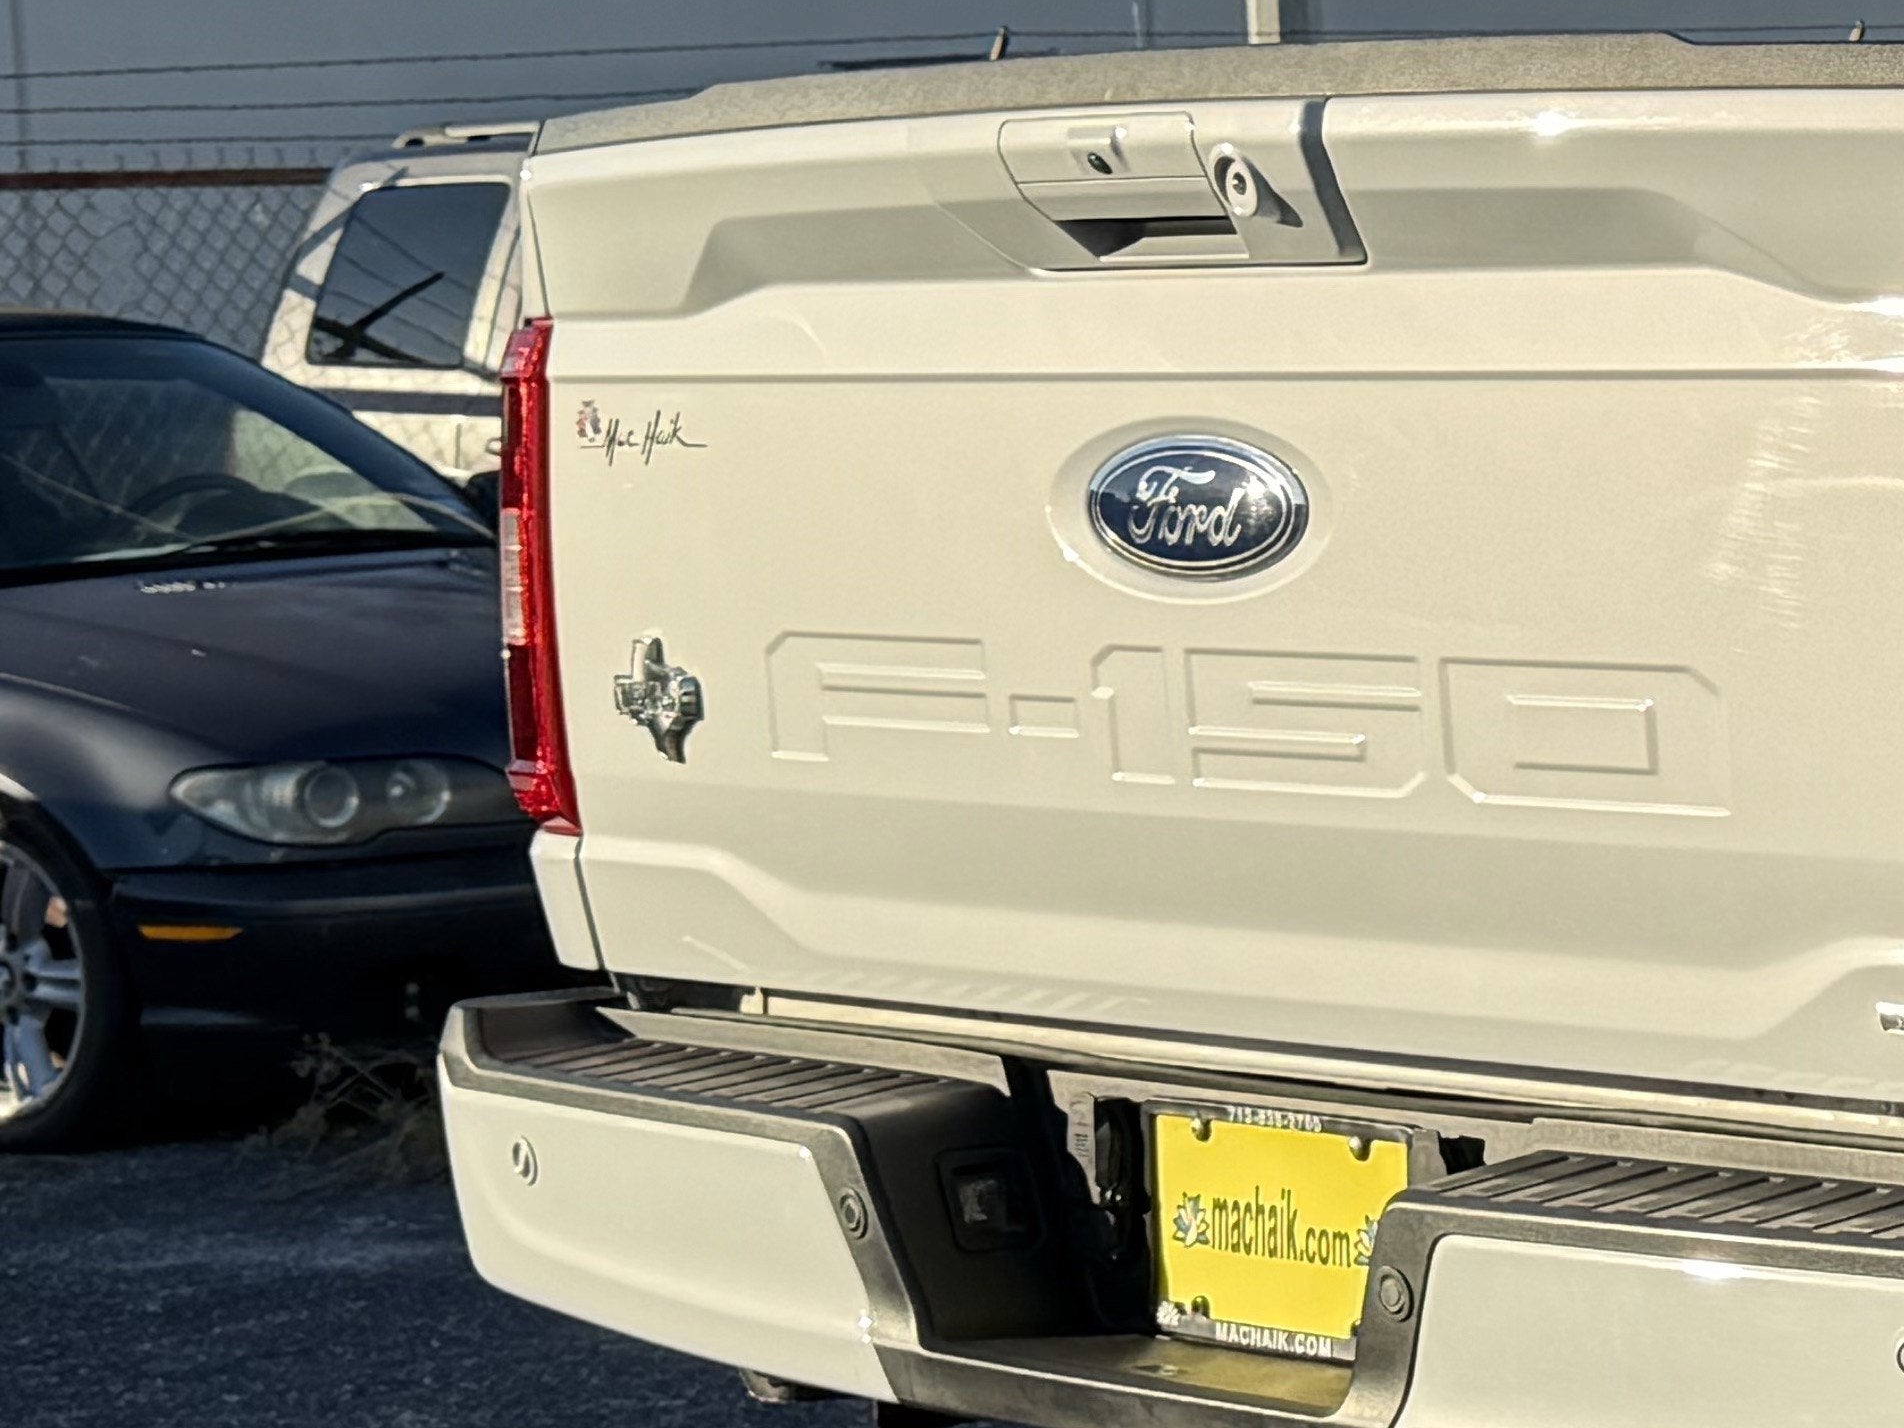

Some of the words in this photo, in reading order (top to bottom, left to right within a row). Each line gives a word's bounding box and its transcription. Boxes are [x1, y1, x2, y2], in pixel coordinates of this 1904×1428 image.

[641, 409, 708, 467] Haik
[1127, 463, 1243, 547] Ford
[765, 630, 1730, 818] F-150
[1211, 1185, 1352, 1268] machaik.com
[1214, 1322, 1332, 1357] MACHAIK.COM
